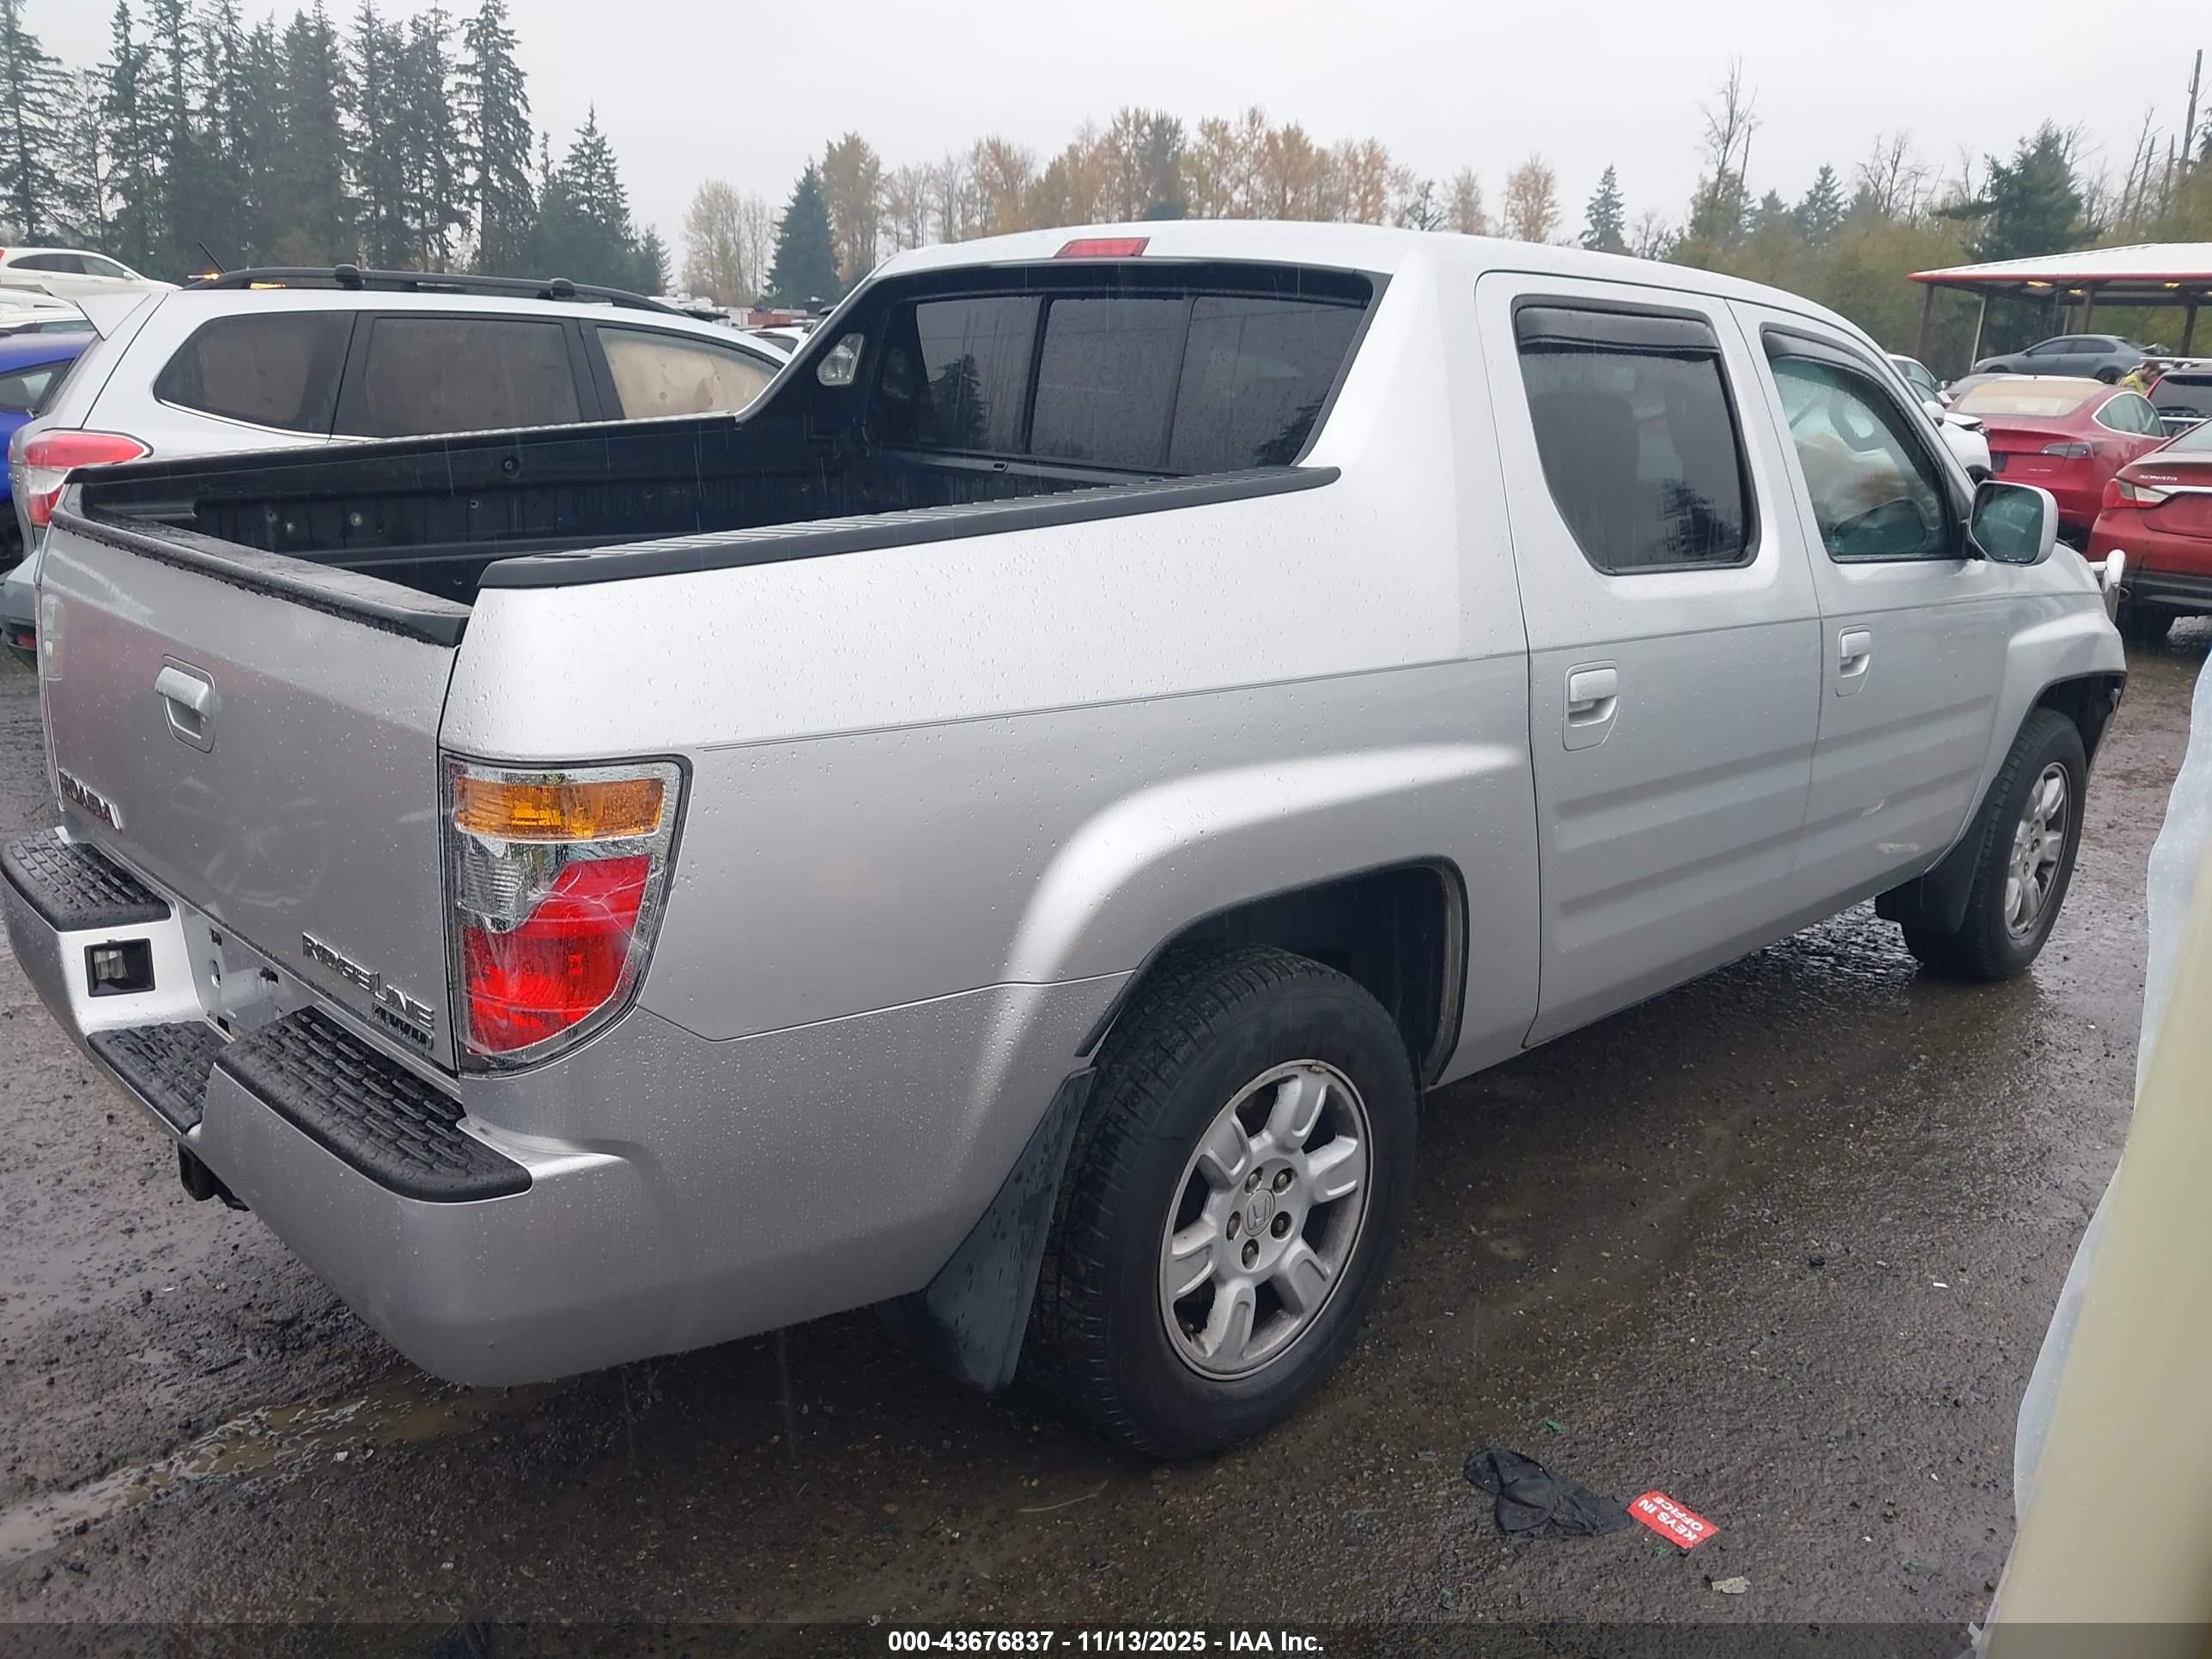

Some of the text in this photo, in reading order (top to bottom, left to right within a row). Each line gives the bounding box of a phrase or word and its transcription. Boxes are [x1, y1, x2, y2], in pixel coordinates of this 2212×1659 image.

[302, 931, 434, 1029] RIDGELINE
[1638, 1498, 1698, 1541] KEYS IN
[1652, 1496, 1704, 1531] OFFICE
